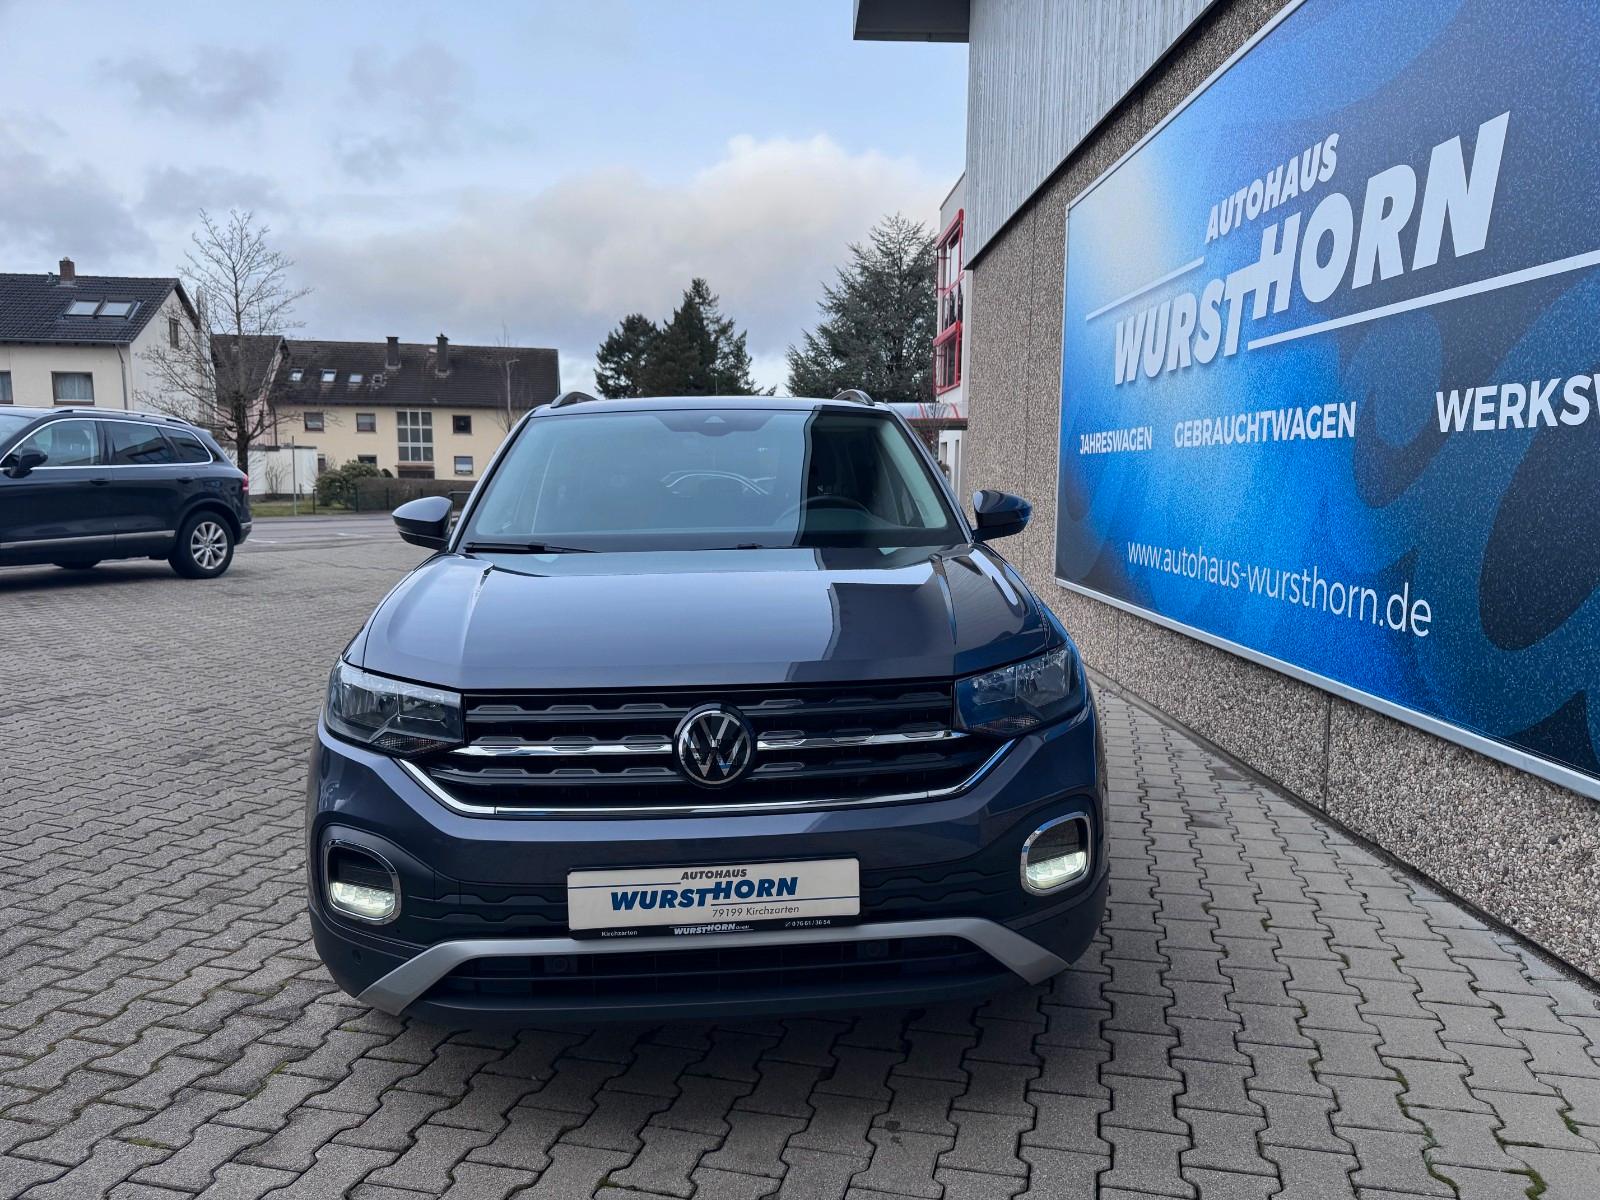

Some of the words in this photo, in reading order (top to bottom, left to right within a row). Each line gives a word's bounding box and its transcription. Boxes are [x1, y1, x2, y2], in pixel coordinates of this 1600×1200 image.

[1204, 132, 1340, 244] AUTOHAUS
[1113, 110, 1510, 386] WURSTHORN
[1079, 426, 1153, 454] JAHRESWAGEN
[1173, 401, 1357, 449] GEBRAUCHTWAGEN
[1436, 373, 1600, 433] WERKS
[1127, 538, 1433, 638] www.autohaus-wursthorn.de
[611, 877, 798, 910] WURSTHORN
[681, 868, 747, 881] AUTOHAUS
[674, 923, 736, 935] WURSTHORN
[712, 907, 743, 918] 79199
[746, 905, 800, 916] Kirchzarten
